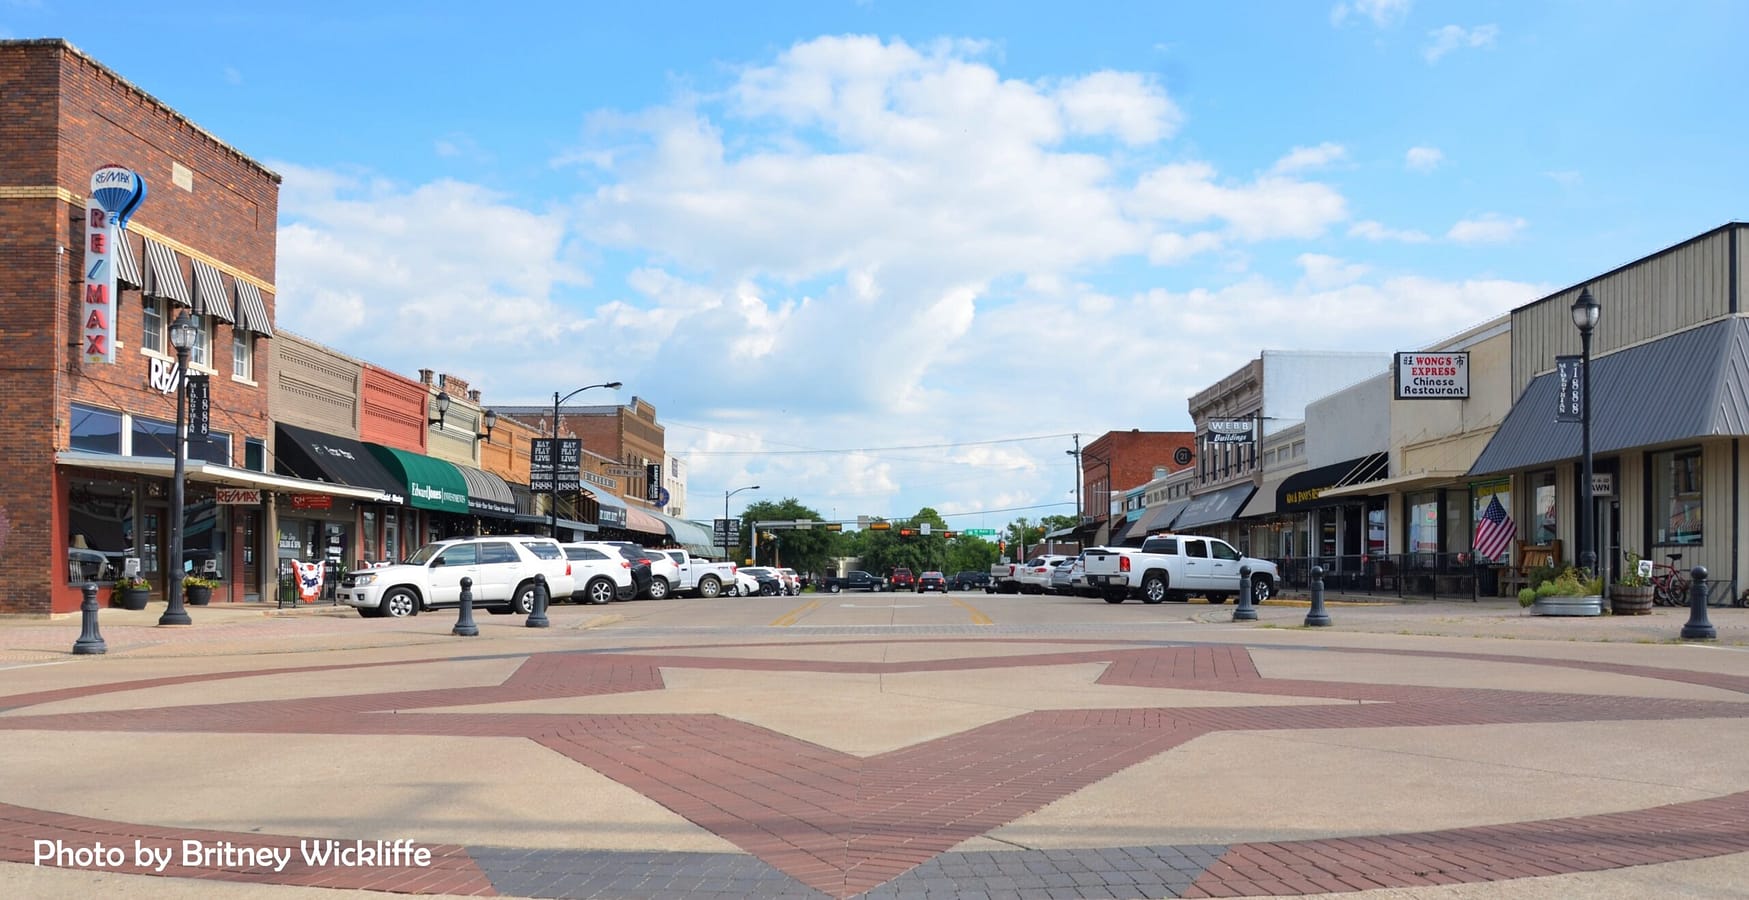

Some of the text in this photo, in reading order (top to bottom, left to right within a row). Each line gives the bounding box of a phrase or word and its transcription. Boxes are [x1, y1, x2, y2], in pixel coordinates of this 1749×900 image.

[95, 170, 131, 185] RE/MAX
[1412, 367, 1456, 376] EXPRESS
[1413, 377, 1455, 386] Chinese
[1404, 385, 1465, 394] Restaurant
[201, 387, 209, 434] 1888
[1212, 422, 1249, 430] WEBB
[1214, 433, 1247, 442] Buildings
[531, 482, 553, 490] 1888
[558, 482, 580, 490] 1888
[217, 490, 258, 503] RE/MAX
